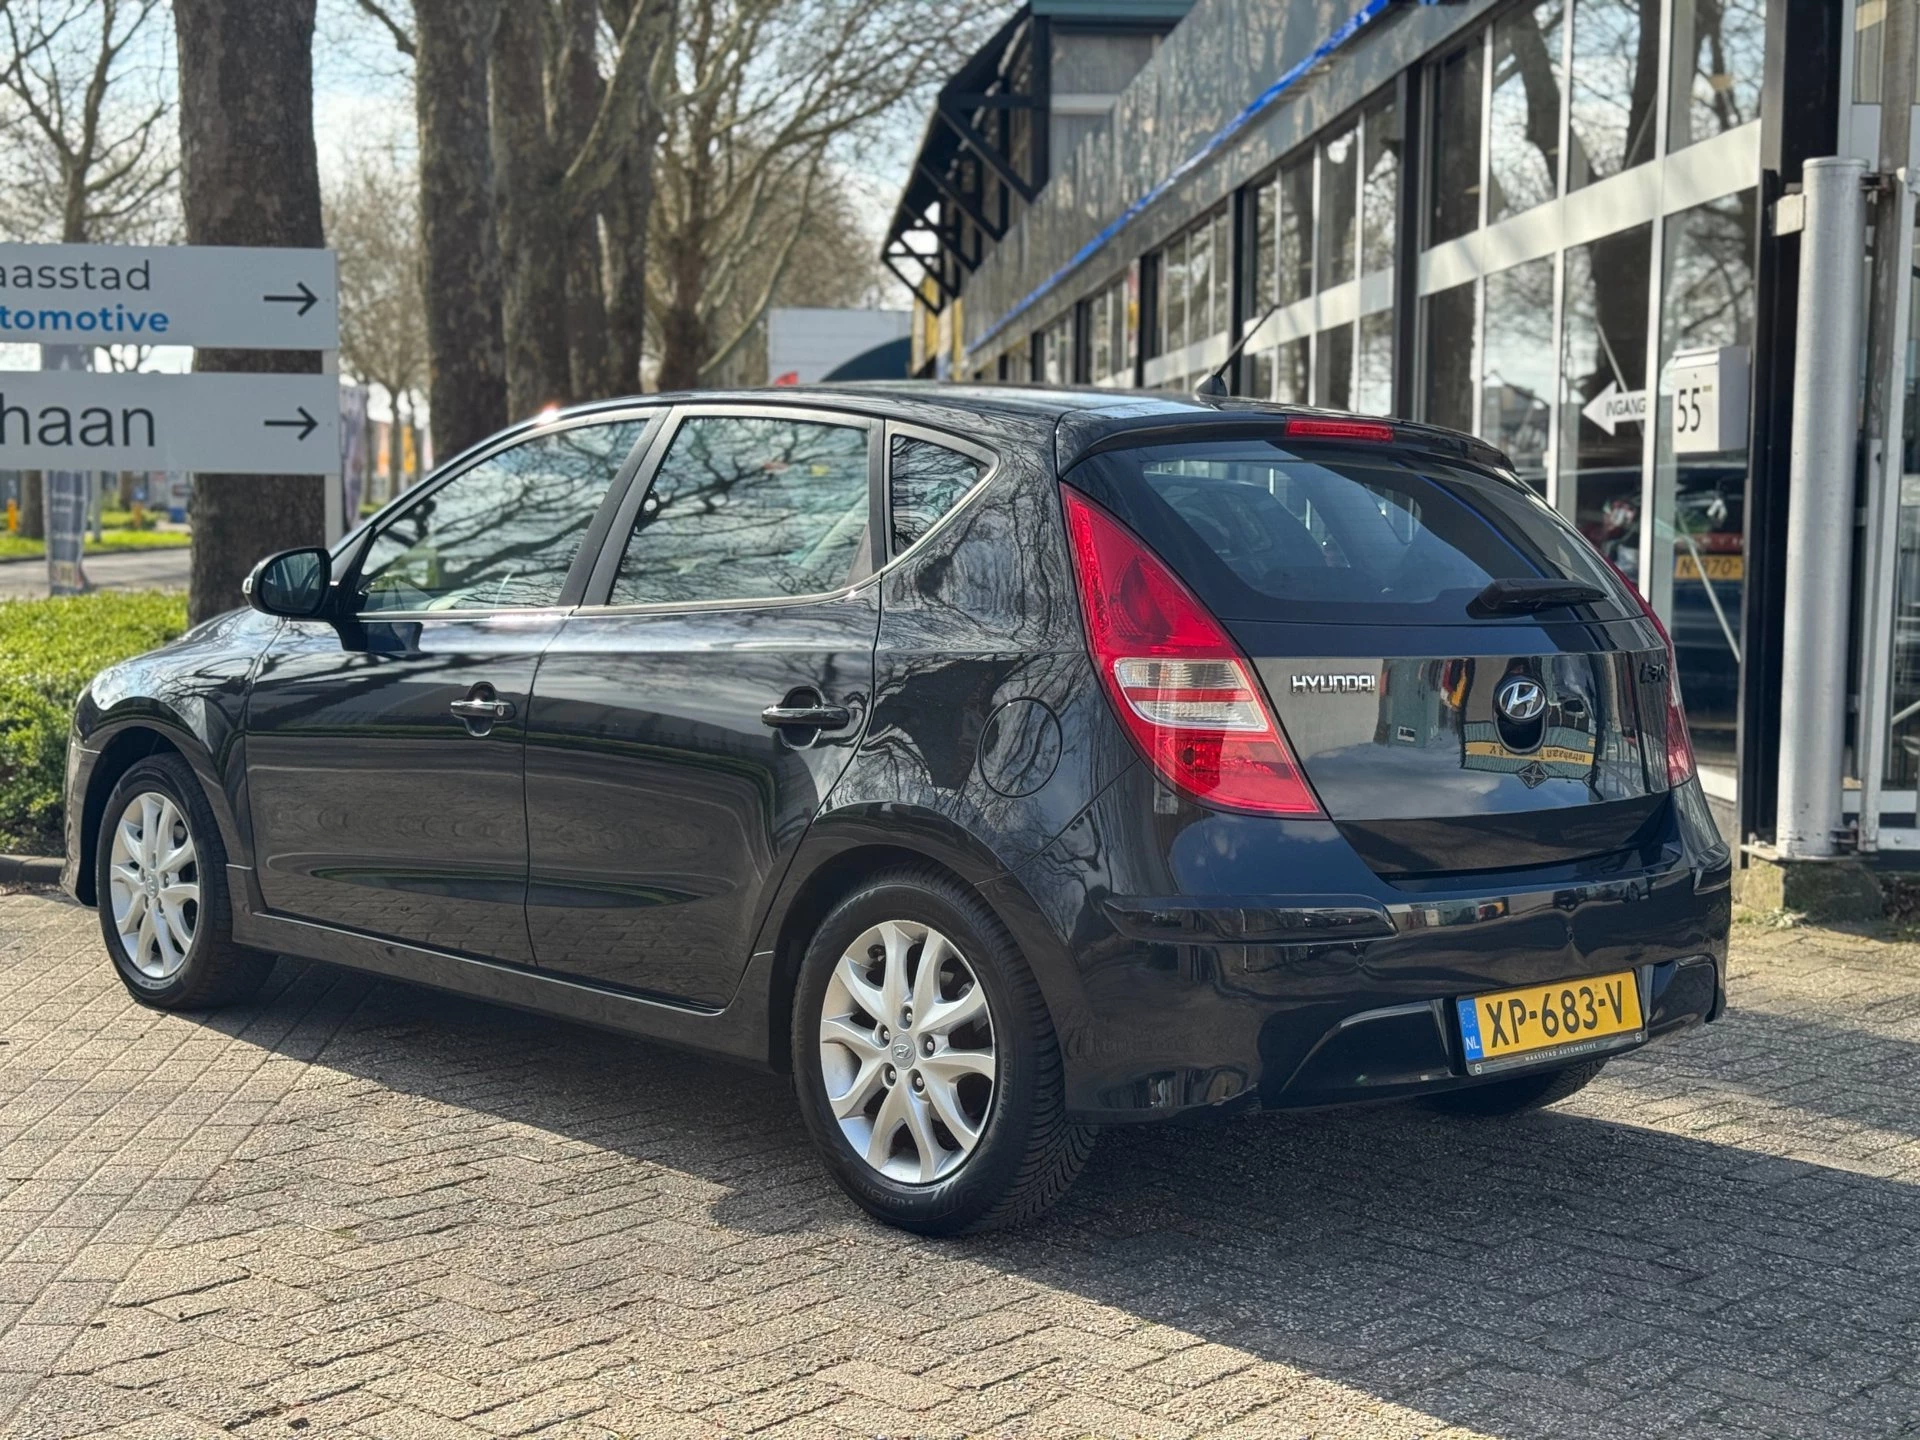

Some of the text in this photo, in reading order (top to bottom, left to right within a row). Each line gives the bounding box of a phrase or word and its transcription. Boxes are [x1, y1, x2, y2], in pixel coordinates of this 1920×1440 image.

[0, 303, 170, 332] tomotive
[0, 392, 155, 447] haan
[1677, 387, 1701, 433] 55
[1290, 674, 1377, 693] HYUNDAI
[1485, 980, 1623, 1049] XP-683-V
[1465, 1035, 1480, 1050] NL
[1524, 1042, 1597, 1061] MAASSTAD AUTOMOTIVE
